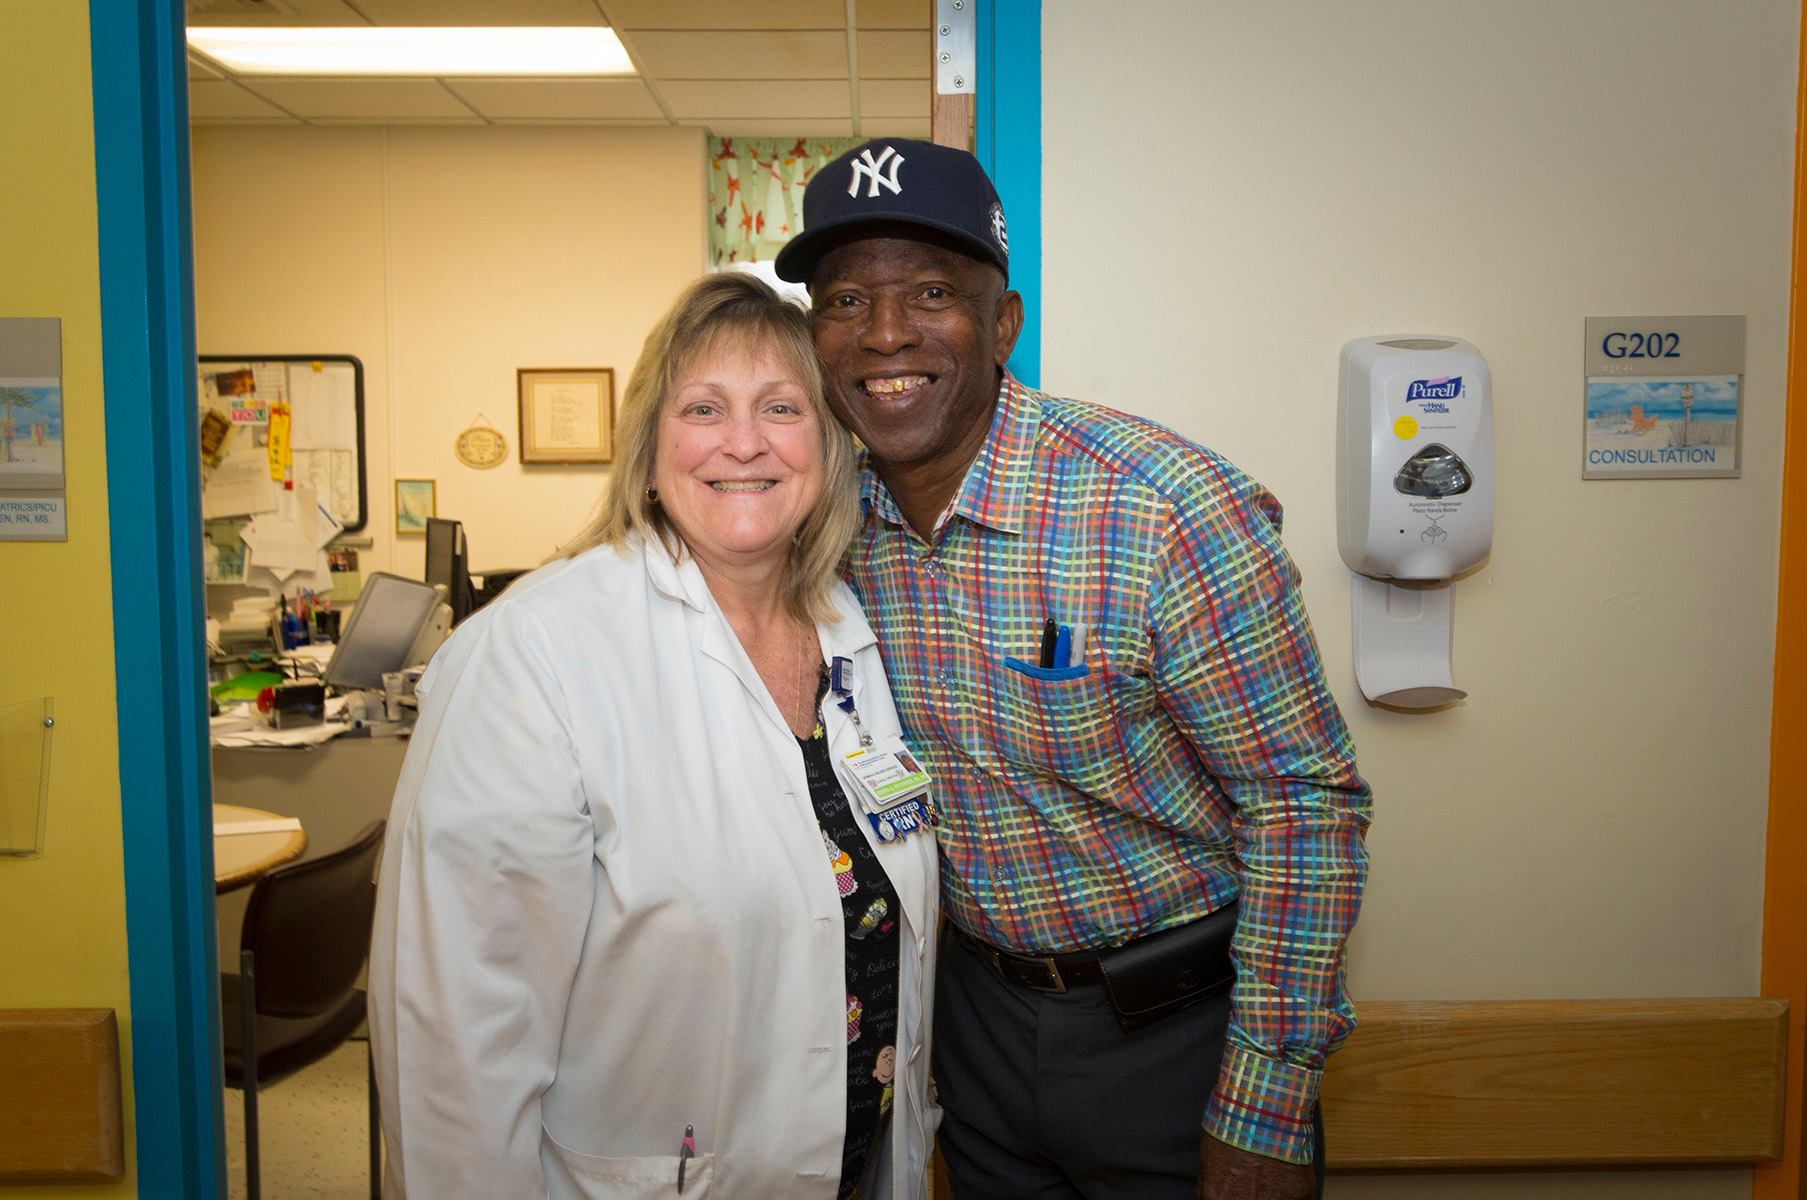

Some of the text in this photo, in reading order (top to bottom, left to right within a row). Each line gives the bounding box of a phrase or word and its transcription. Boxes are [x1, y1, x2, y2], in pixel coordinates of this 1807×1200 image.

[848, 145, 905, 199] NY
[1602, 332, 1681, 359] G202
[1412, 383, 1456, 397] Purell
[1589, 449, 1716, 464] CONSULTATION
[880, 801, 920, 821] CERTIFIED
